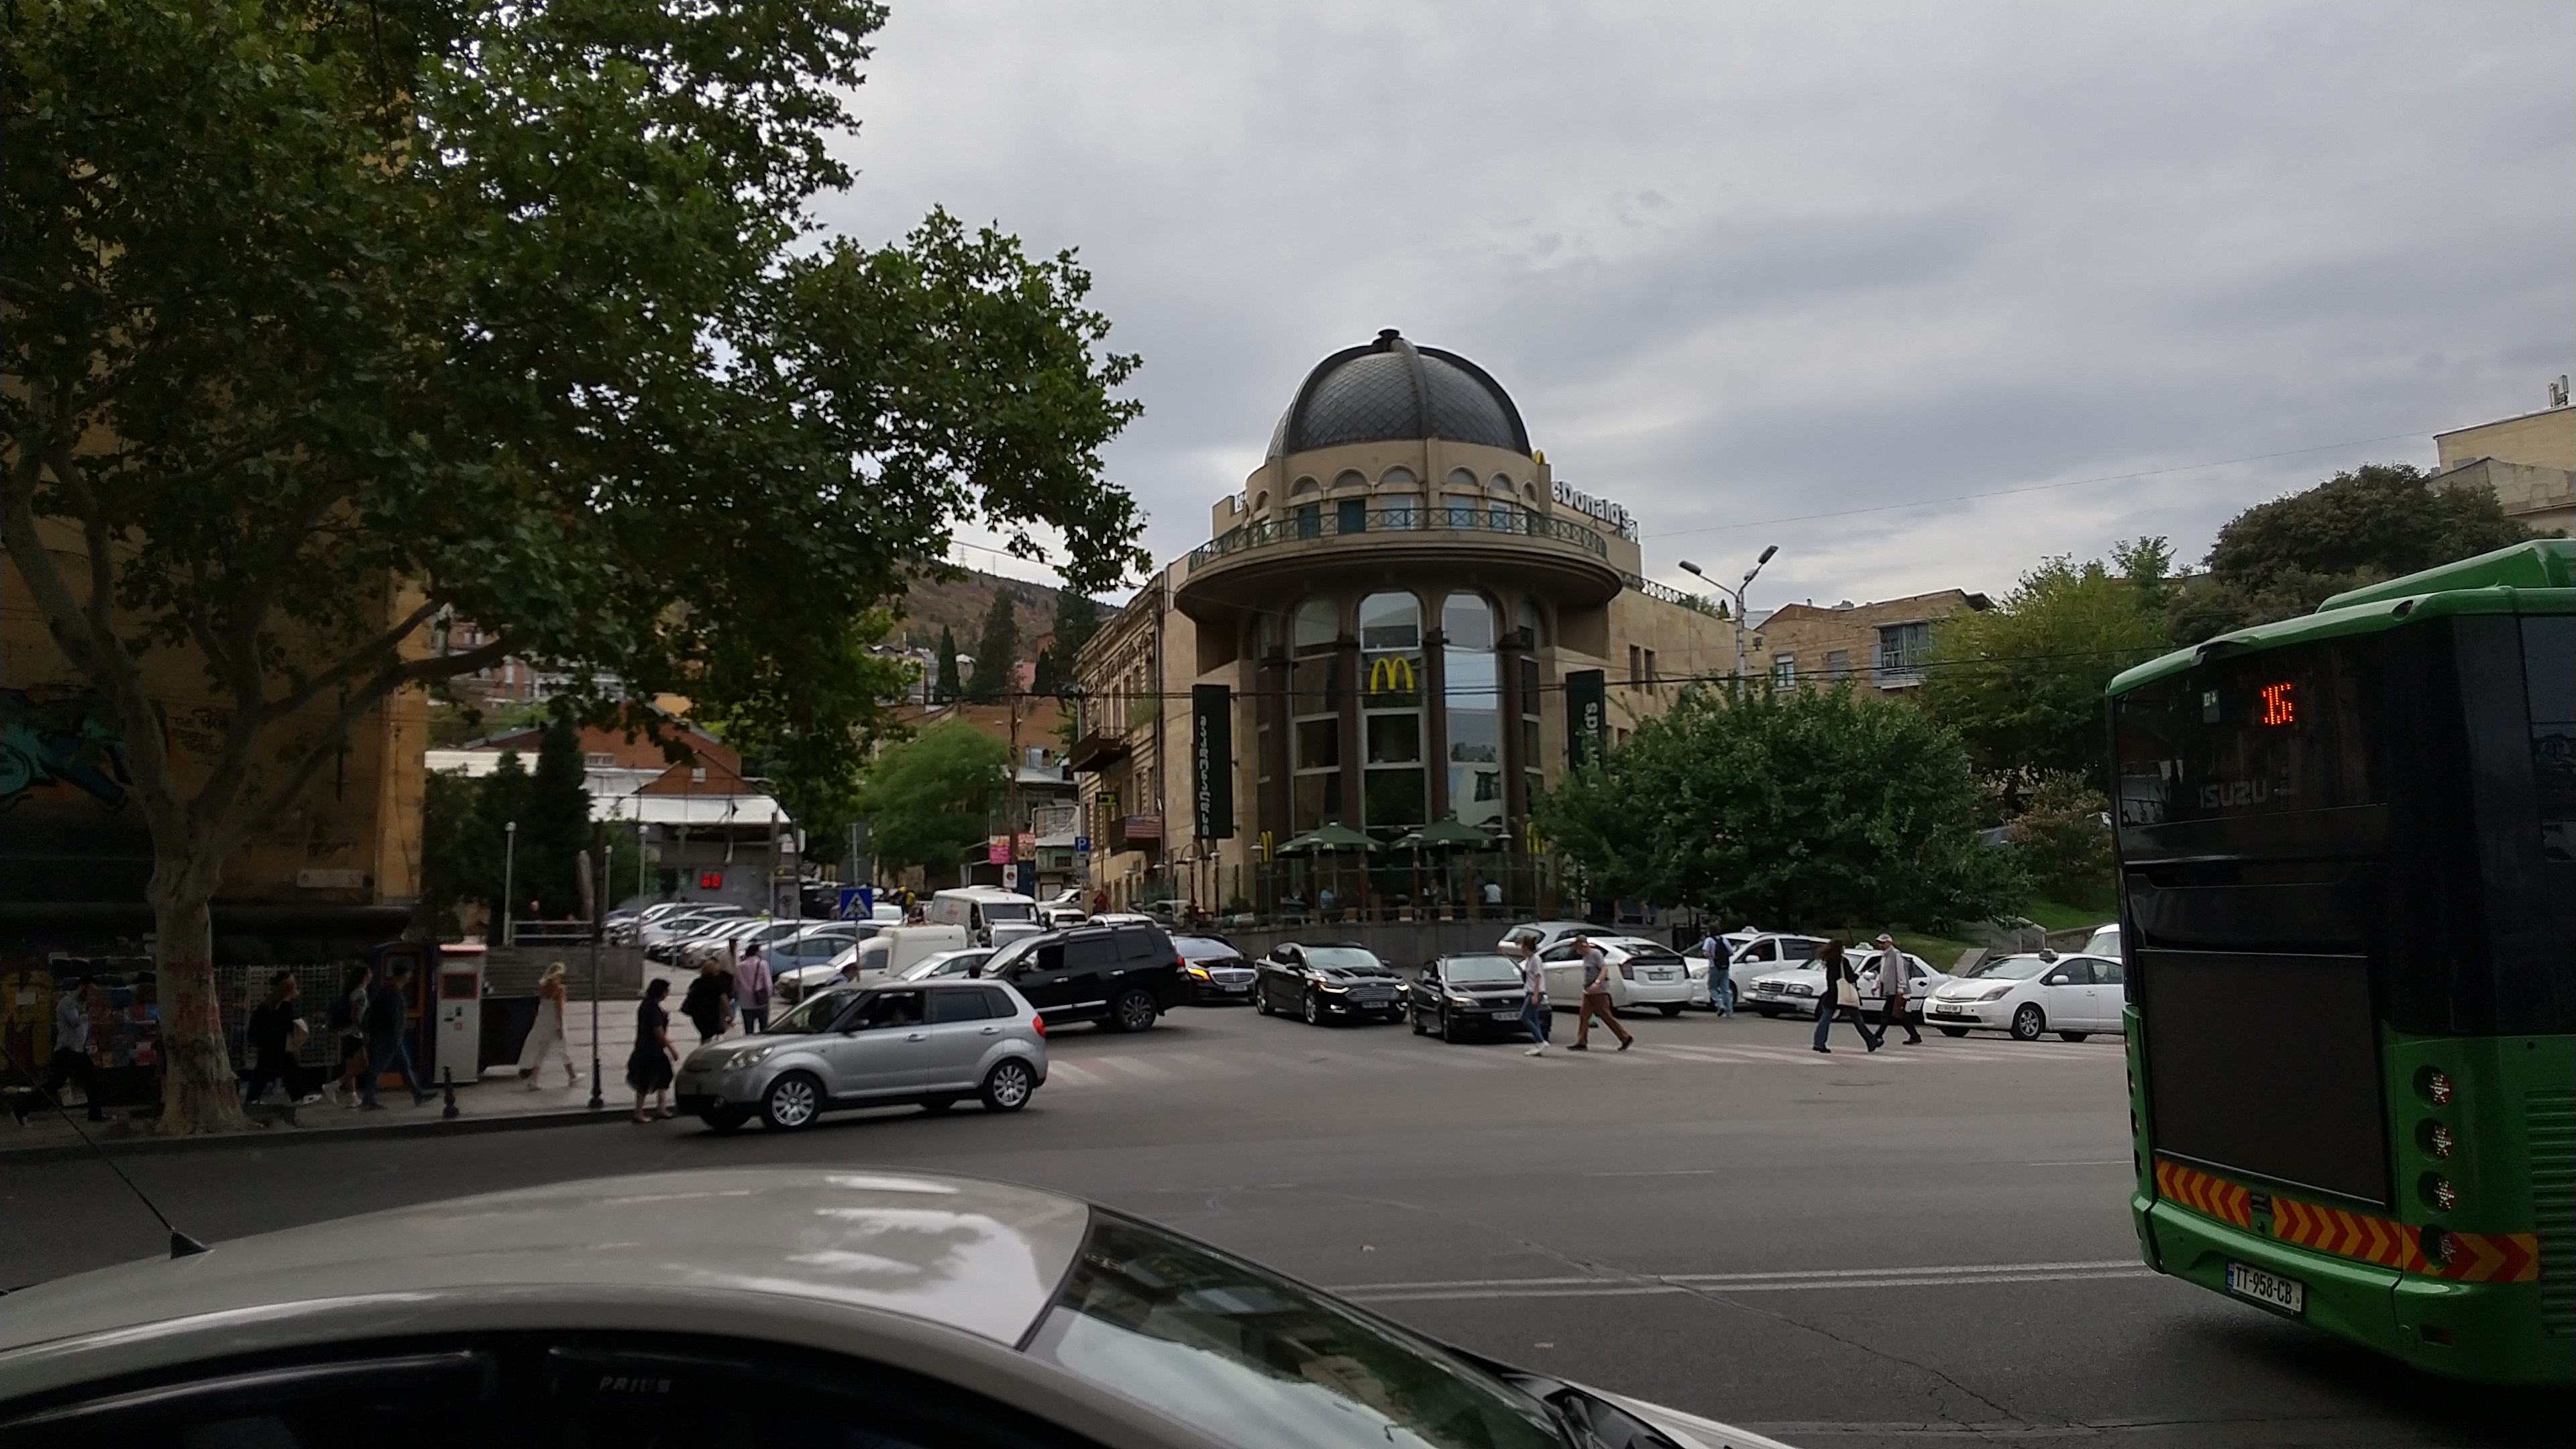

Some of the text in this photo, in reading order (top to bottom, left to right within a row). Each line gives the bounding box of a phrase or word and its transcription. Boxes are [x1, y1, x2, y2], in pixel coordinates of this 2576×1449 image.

[1551, 481, 1630, 529] cDonald's
[2200, 779, 2267, 808] ISUZU
[1077, 838, 1087, 851] P
[2236, 1267, 2292, 1305] TT-958-CB
